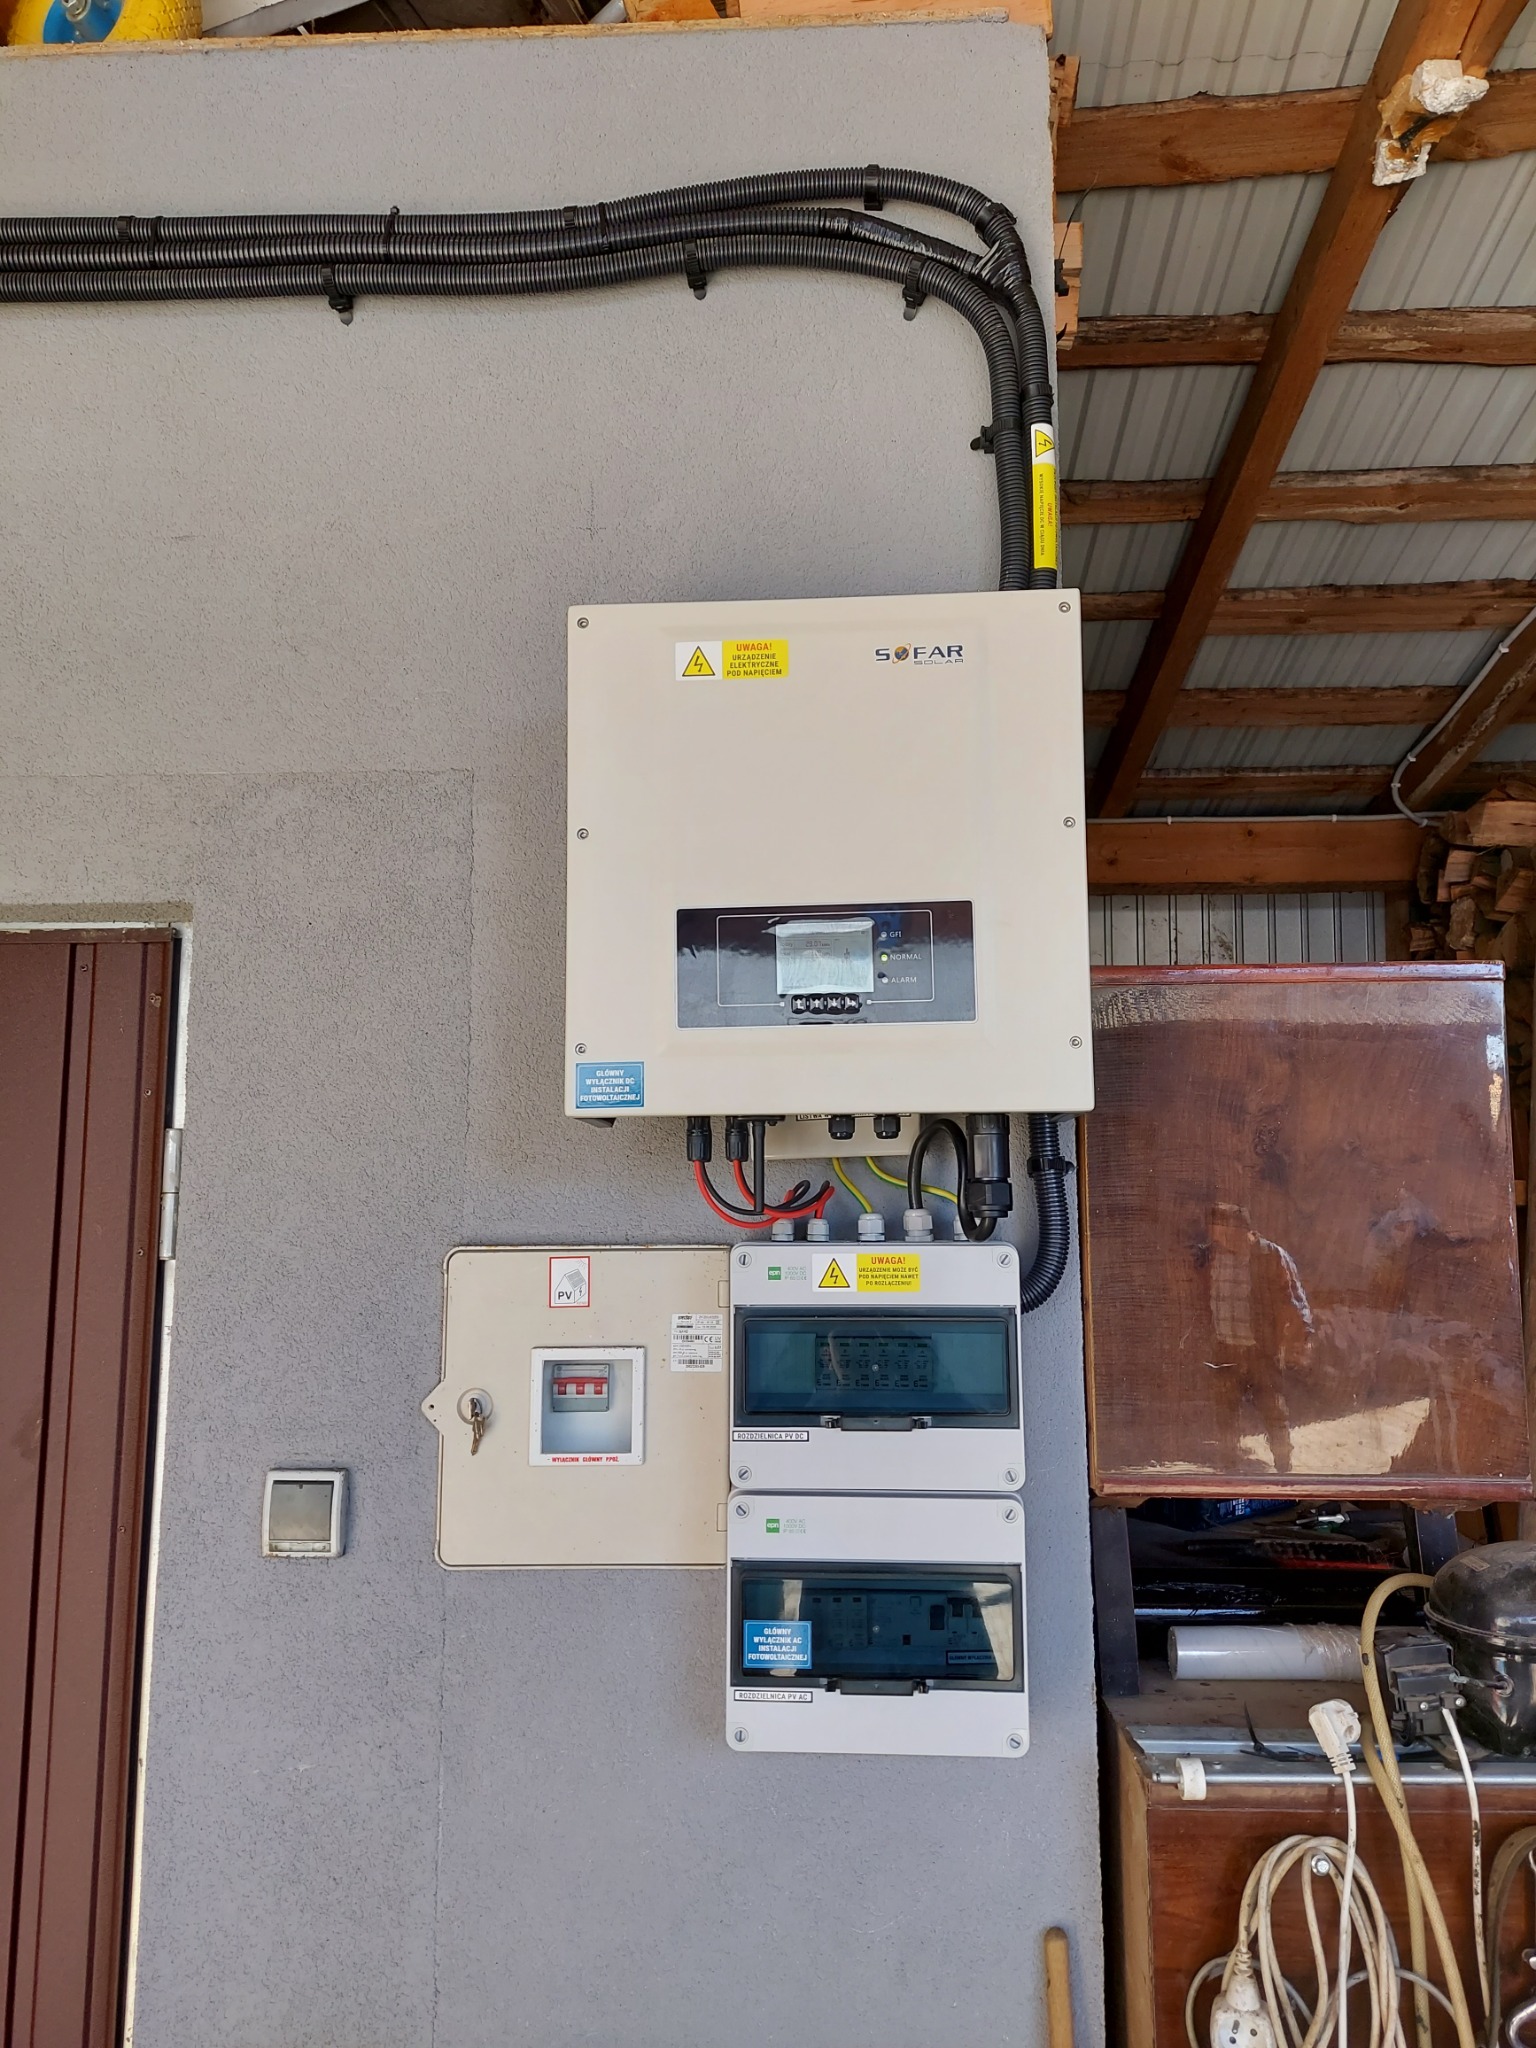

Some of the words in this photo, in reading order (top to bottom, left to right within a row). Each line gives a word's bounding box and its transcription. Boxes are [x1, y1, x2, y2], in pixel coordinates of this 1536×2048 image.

[736, 643, 772, 652] UWAGA!
[732, 653, 776, 662] URZĄDZENIE
[875, 644, 964, 662] SOFAR
[730, 661, 779, 669] ELEKTRYCZNE
[743, 668, 782, 678] NAPIĘCIEM
[558, 1291, 572, 1300] PV
